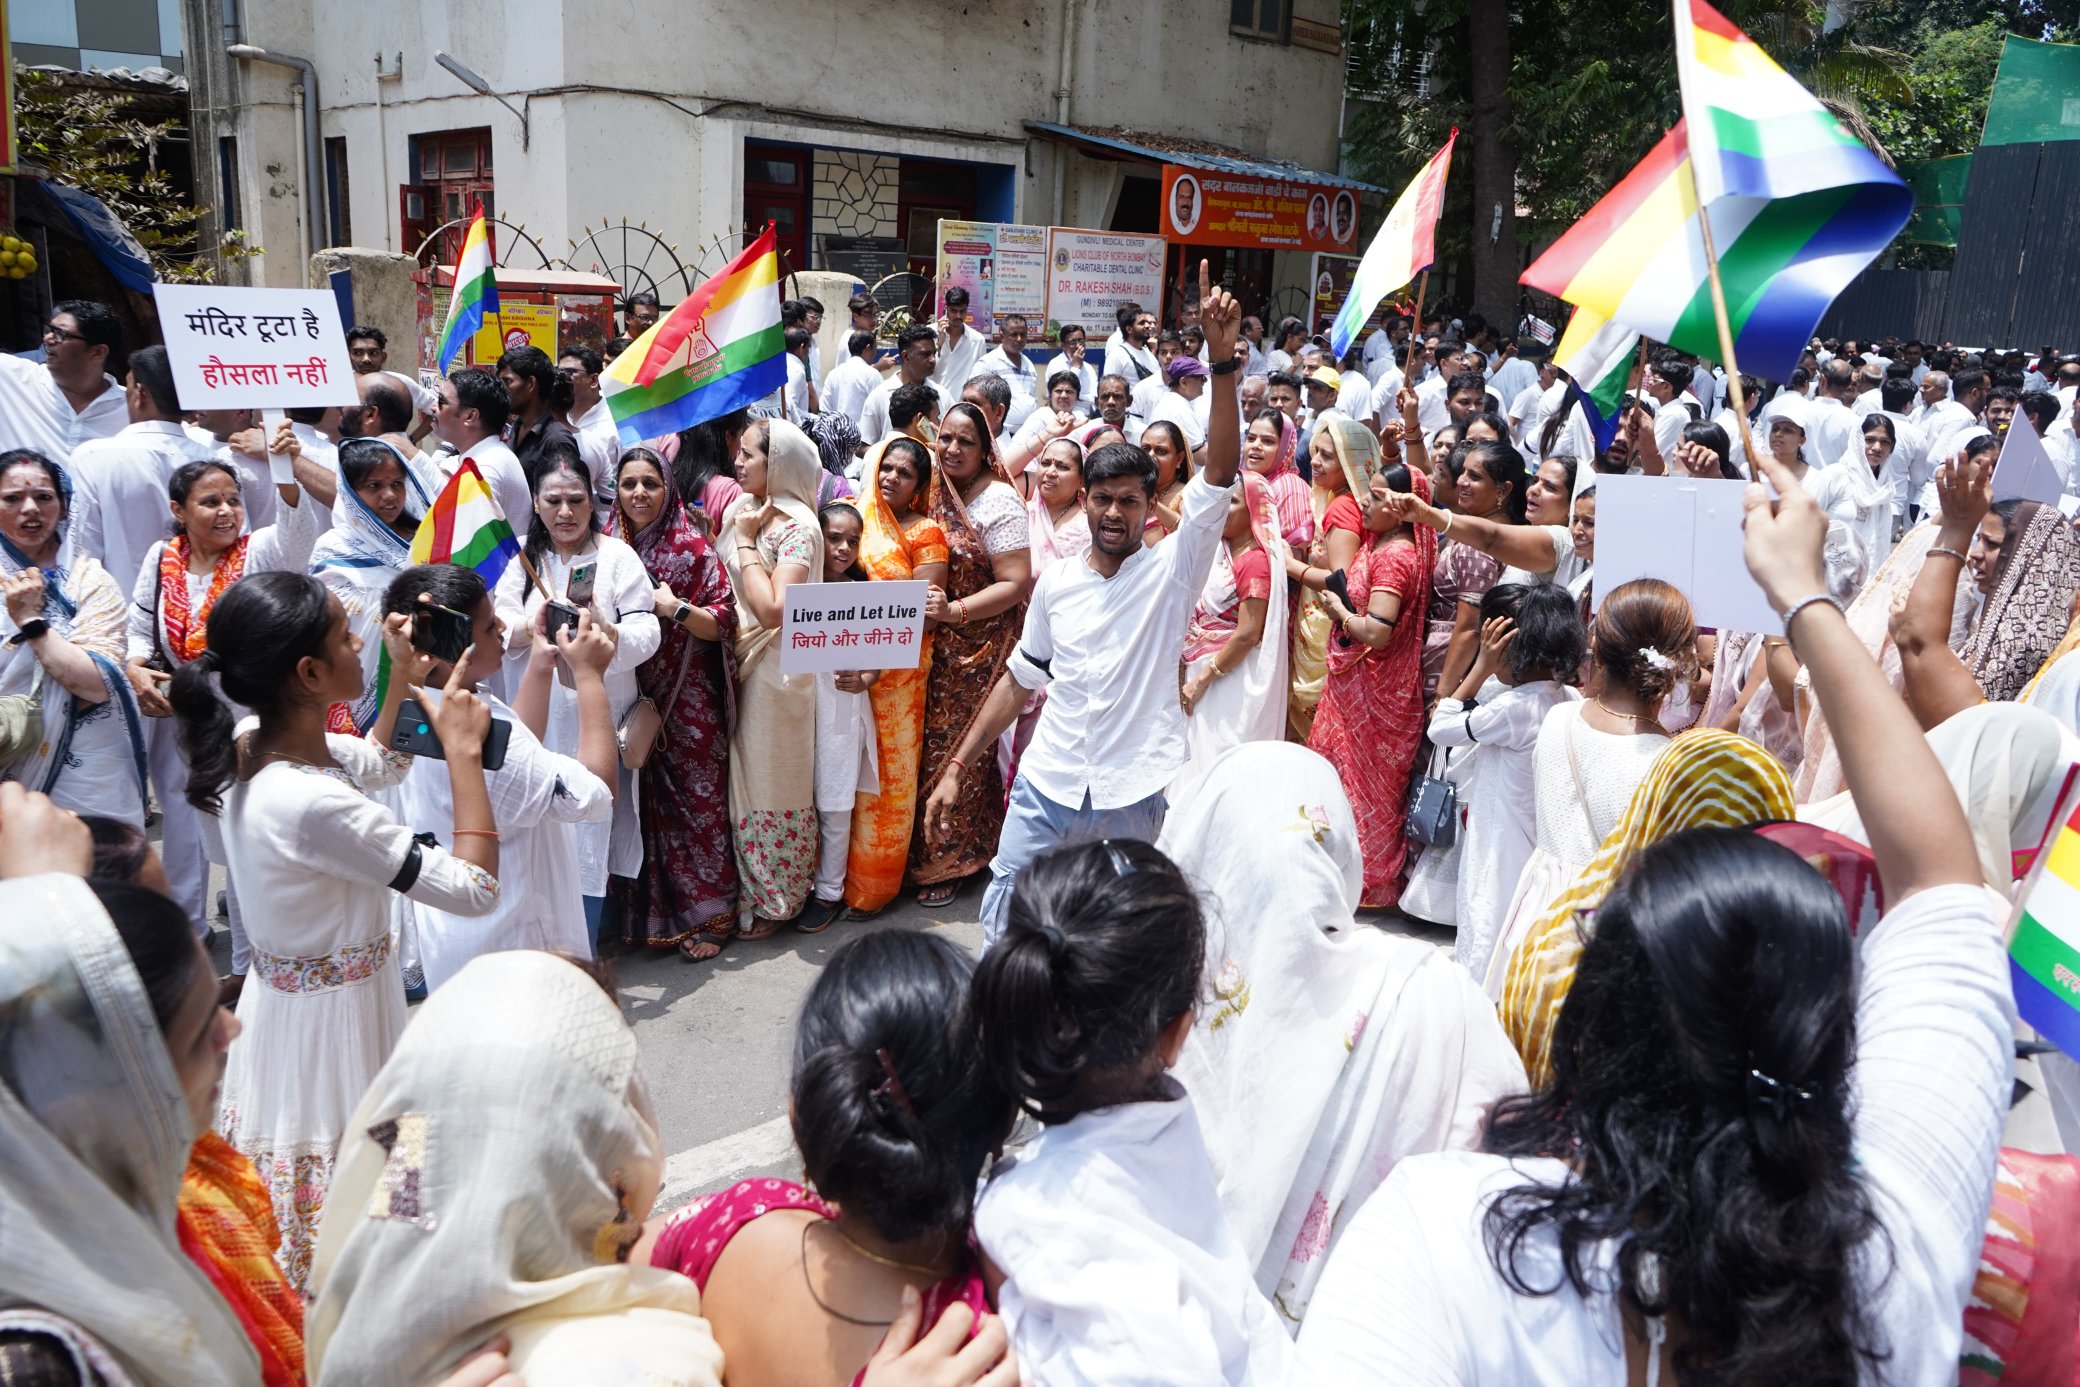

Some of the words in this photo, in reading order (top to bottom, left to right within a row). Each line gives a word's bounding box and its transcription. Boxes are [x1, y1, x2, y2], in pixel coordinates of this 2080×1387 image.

[1103, 238, 1124, 246] MEDICAL
[1126, 239, 1145, 247] CENTER
[1072, 250, 1087, 259] LIONS
[1088, 250, 1101, 260] CLUB
[1103, 251, 1110, 260] OF
[1111, 251, 1127, 261] NORTH
[1128, 252, 1146, 262] BOMBAY
[1073, 263, 1108, 273] CHARITABLE
[1108, 264, 1127, 273] DENTAL
[1128, 265, 1144, 274] CLINIC
[1058, 280, 1072, 293] DR.
[1076, 281, 1110, 294] RAKESH
[1112, 282, 1132, 294] SHAH
[1081, 299, 1092, 309] (M)
[184, 307, 247, 338] मंदिर
[253, 316, 296, 342] टूटा
[302, 308, 319, 339] है
[199, 355, 278, 388] हौसला
[284, 356, 328, 387] नहीं
[793, 608, 822, 623] Live
[828, 606, 855, 621] and
[860, 606, 883, 620] Let
[888, 605, 917, 618] Live
[792, 631, 827, 649] जियो
[832, 629, 859, 646] और
[864, 628, 894, 645] जीने
[898, 627, 914, 645] दो
